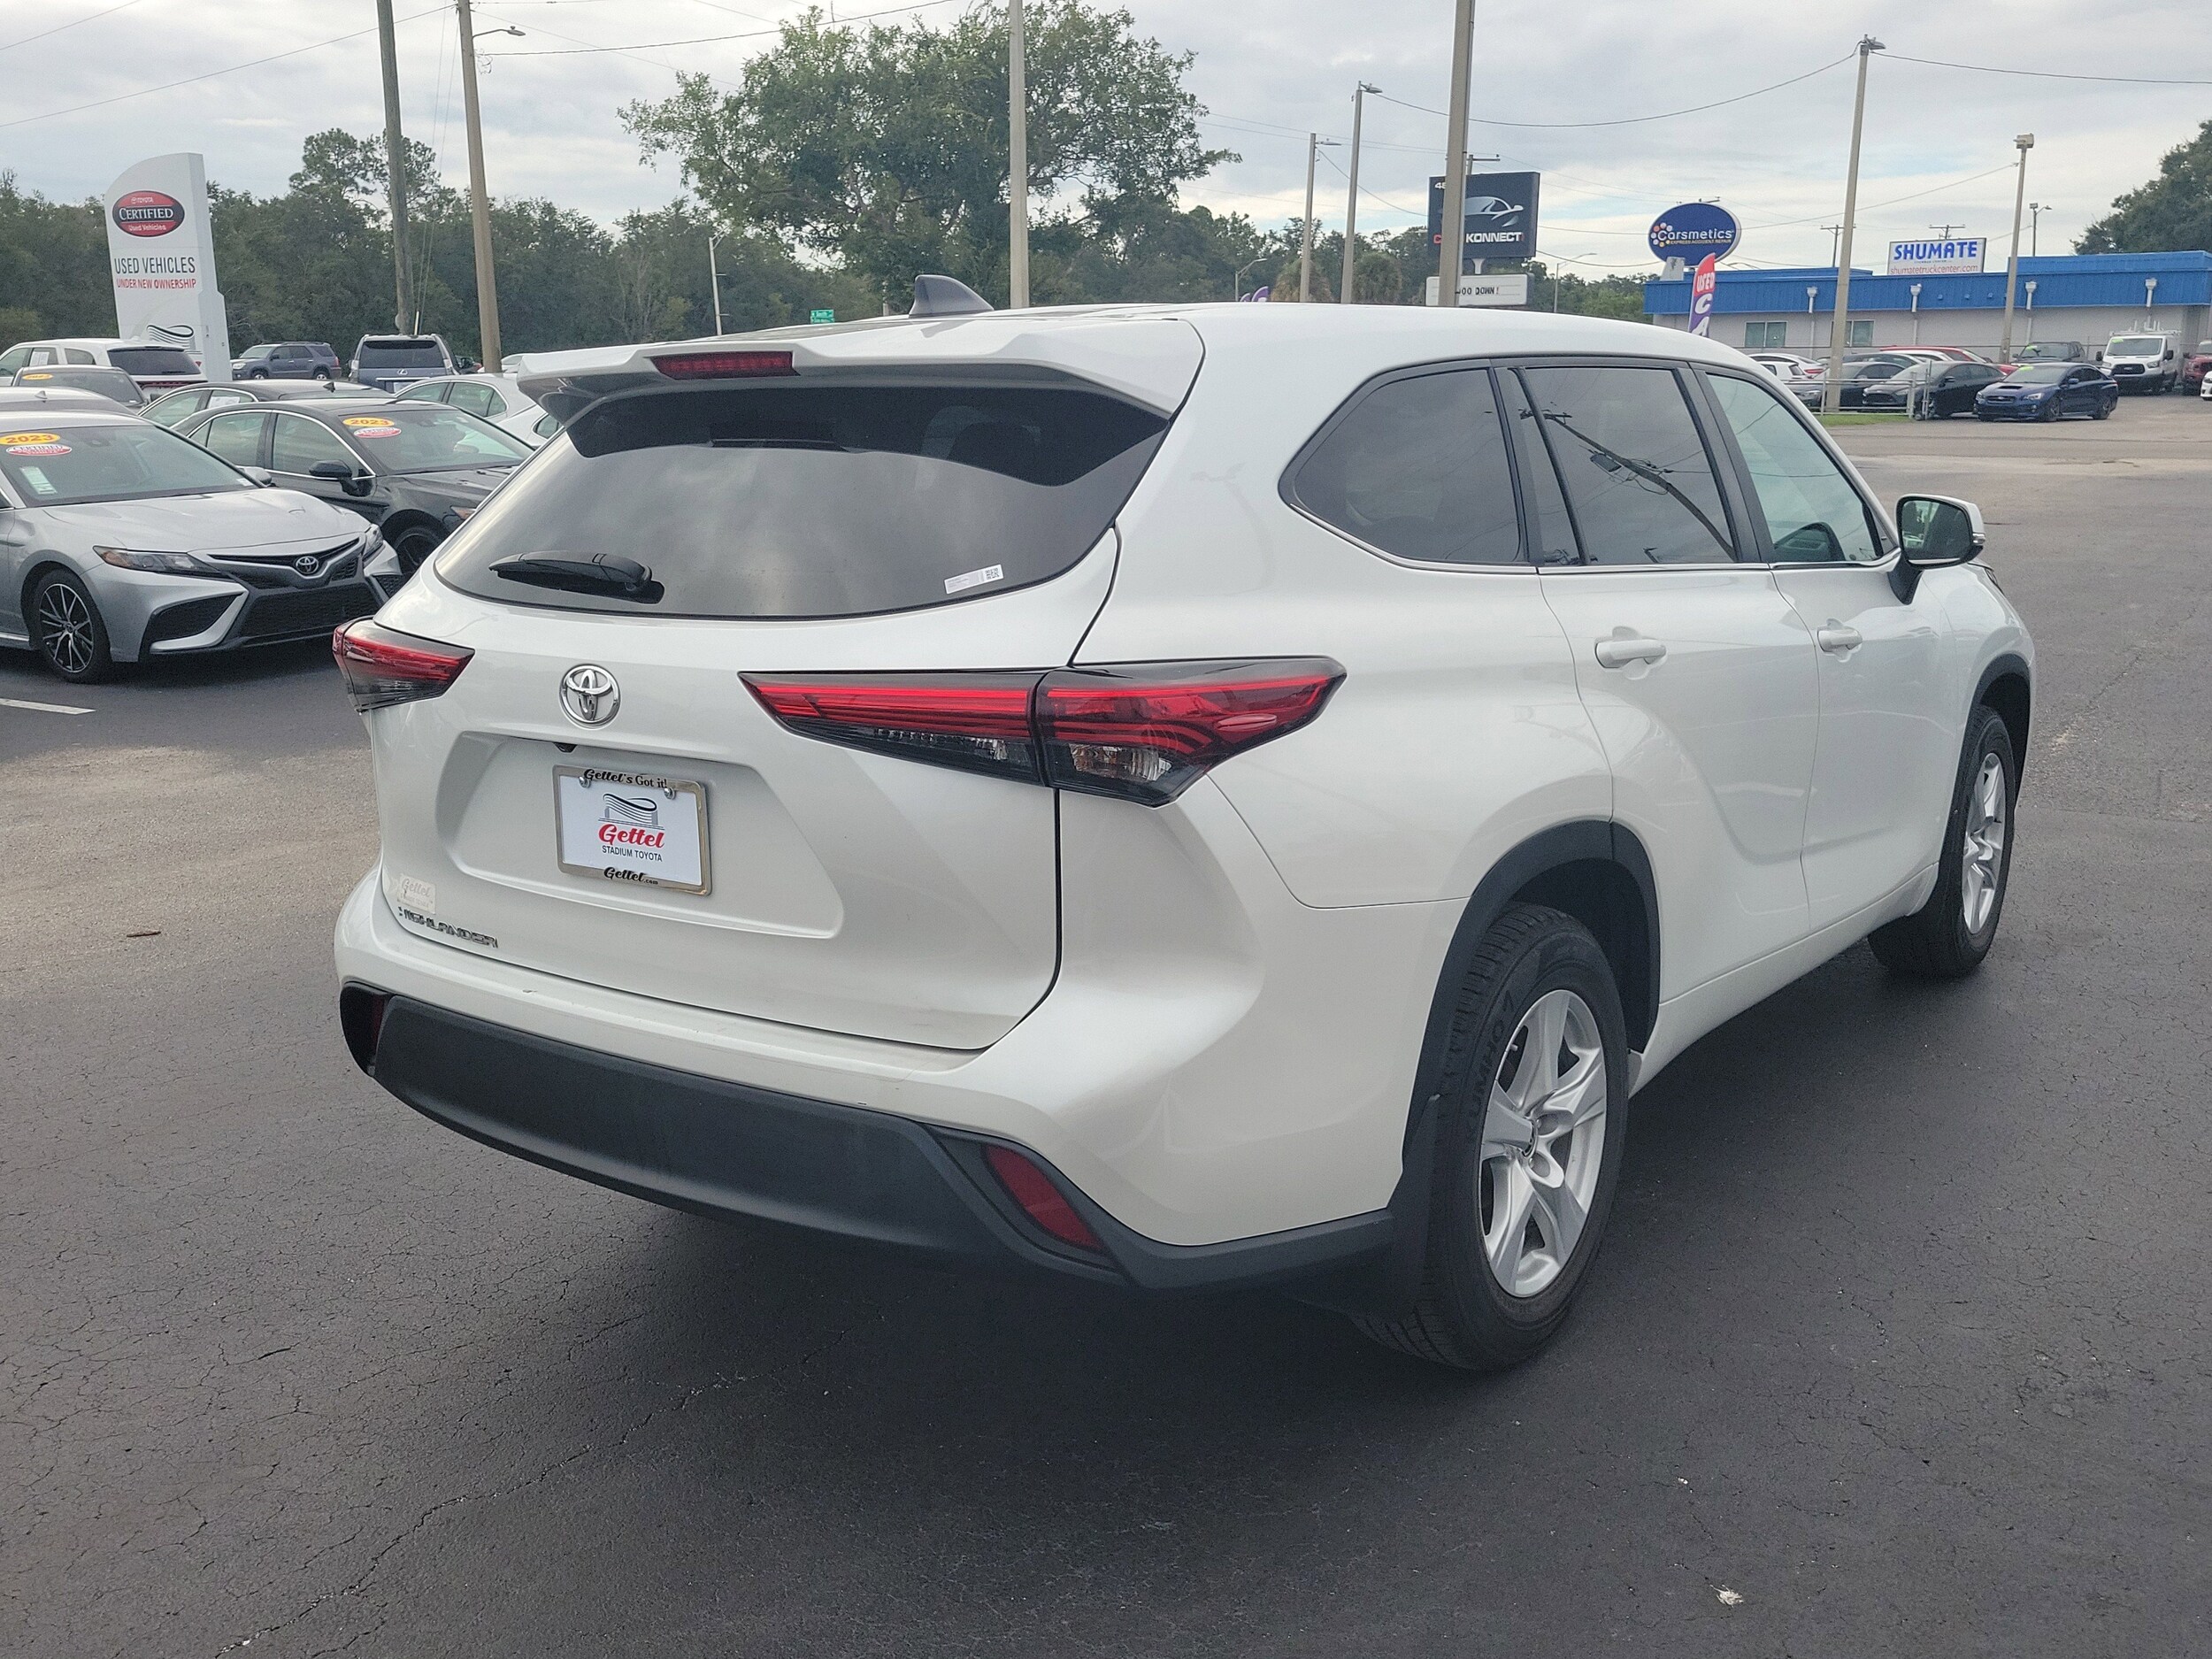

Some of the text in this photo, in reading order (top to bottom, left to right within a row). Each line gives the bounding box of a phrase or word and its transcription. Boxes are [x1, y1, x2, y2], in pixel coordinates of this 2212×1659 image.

[119, 207, 174, 220] CERTIFIED
[1657, 228, 1732, 241] Carsmetics
[1893, 241, 1978, 260] SHUMATE
[114, 257, 196, 273] USED VEHICLES
[1891, 264, 1978, 274] shumatetruckcenter.com
[117, 279, 196, 288] UNDER NEW OWNERSHIP
[1696, 272, 1716, 293] USED
[5, 434, 54, 443] 2023
[584, 768, 667, 788] Gettel's Got it!
[598, 824, 665, 848] Gettel
[602, 845, 663, 862] STADIUM TOYOTA
[402, 878, 431, 898] Gettel
